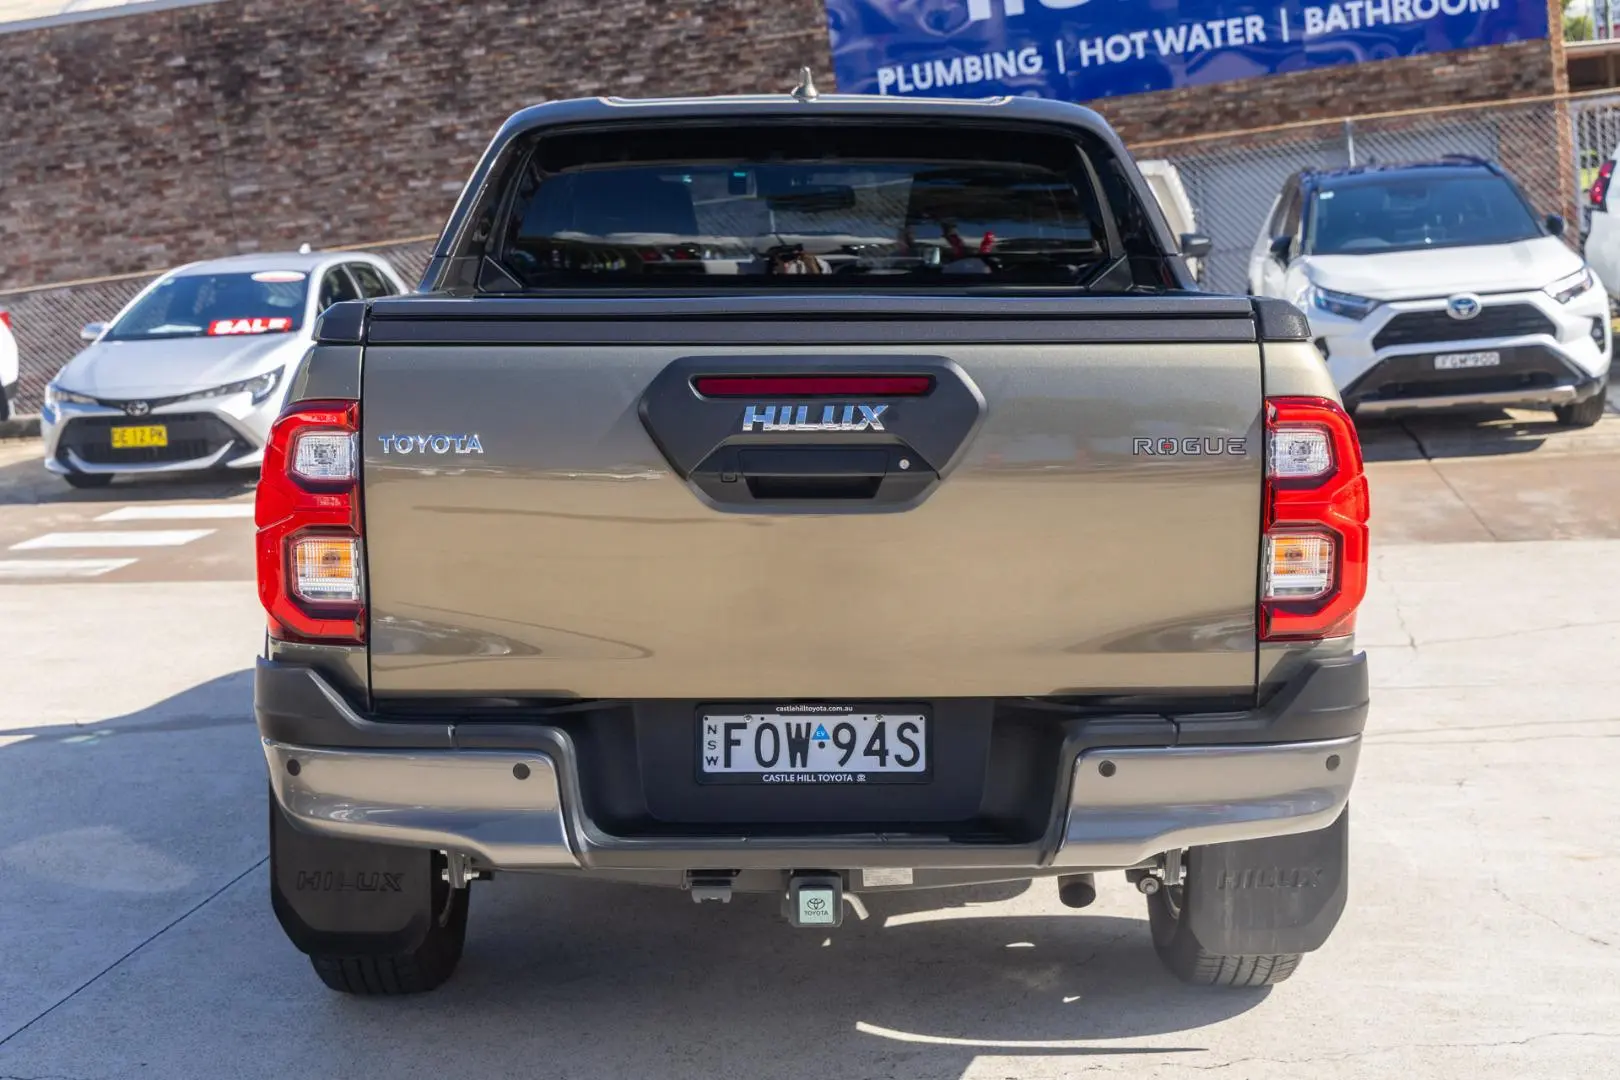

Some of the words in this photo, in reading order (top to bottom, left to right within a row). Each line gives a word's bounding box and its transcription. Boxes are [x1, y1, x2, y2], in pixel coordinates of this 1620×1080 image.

[877, 47, 1044, 96] PLUMBING
[1079, 30, 1149, 68] HOT
[1152, 15, 1267, 56] WATER
[214, 318, 288, 335] SALE
[742, 405, 889, 432] HILUX
[378, 433, 484, 454] TOYOTA
[1132, 437, 1247, 456] ROGUE
[775, 705, 853, 713] castlehilltoyota.com.au
[762, 774, 795, 782] CASTLE
[797, 774, 817, 782] HILL
[818, 774, 853, 782] TOYOTA
[296, 870, 405, 892] HILUX
